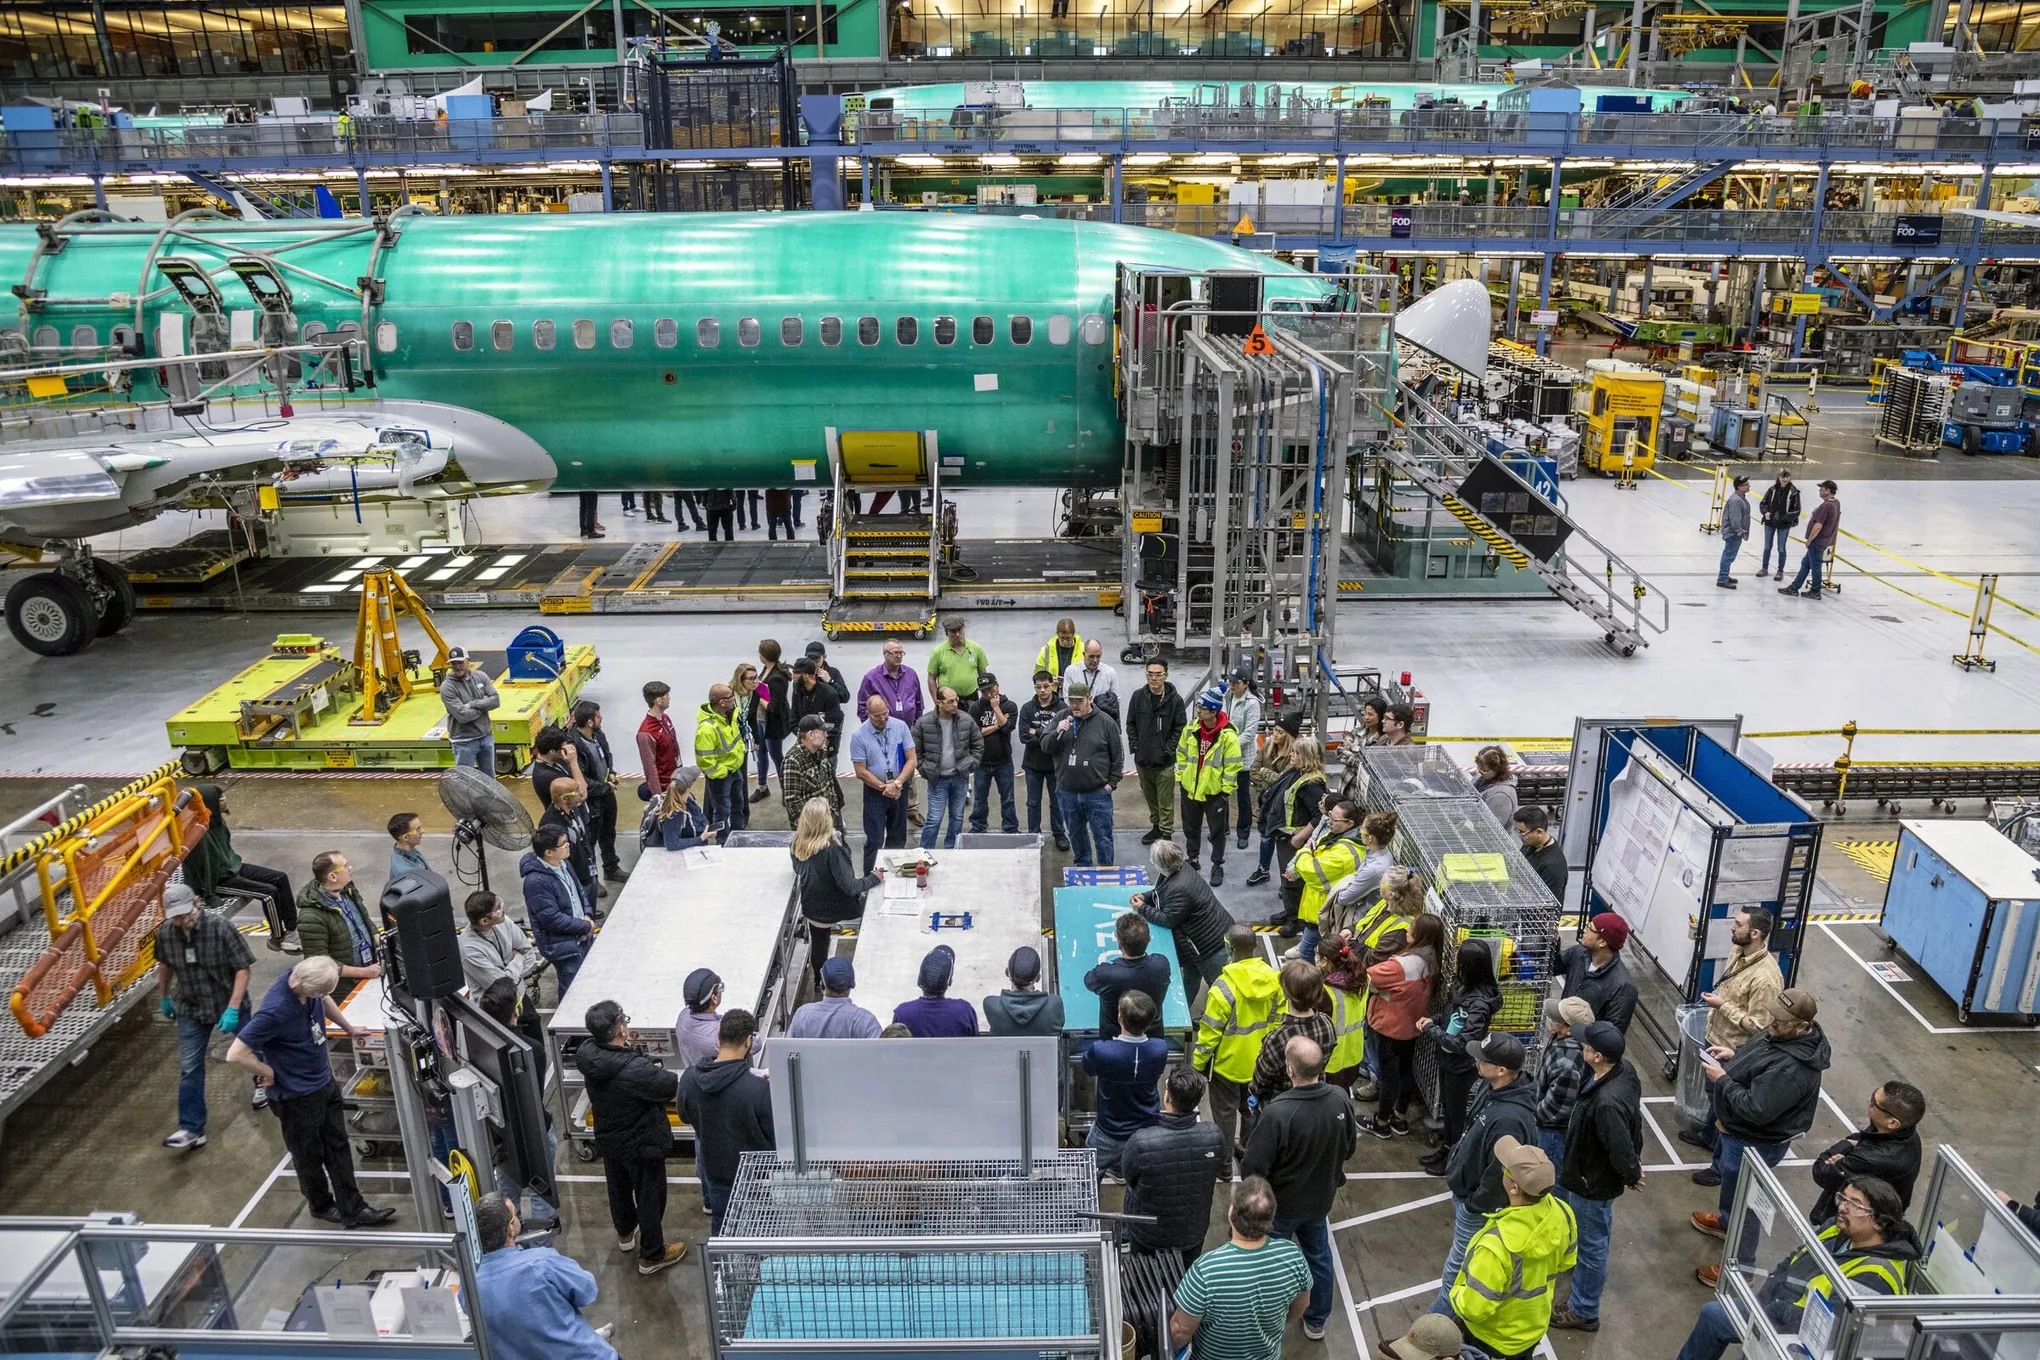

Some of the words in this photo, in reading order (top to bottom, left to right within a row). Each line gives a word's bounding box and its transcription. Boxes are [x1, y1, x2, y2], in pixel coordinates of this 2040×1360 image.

[1392, 217, 1410, 226] FOD
[1896, 227, 1915, 236] FOD
[1252, 334, 1265, 351] 5
